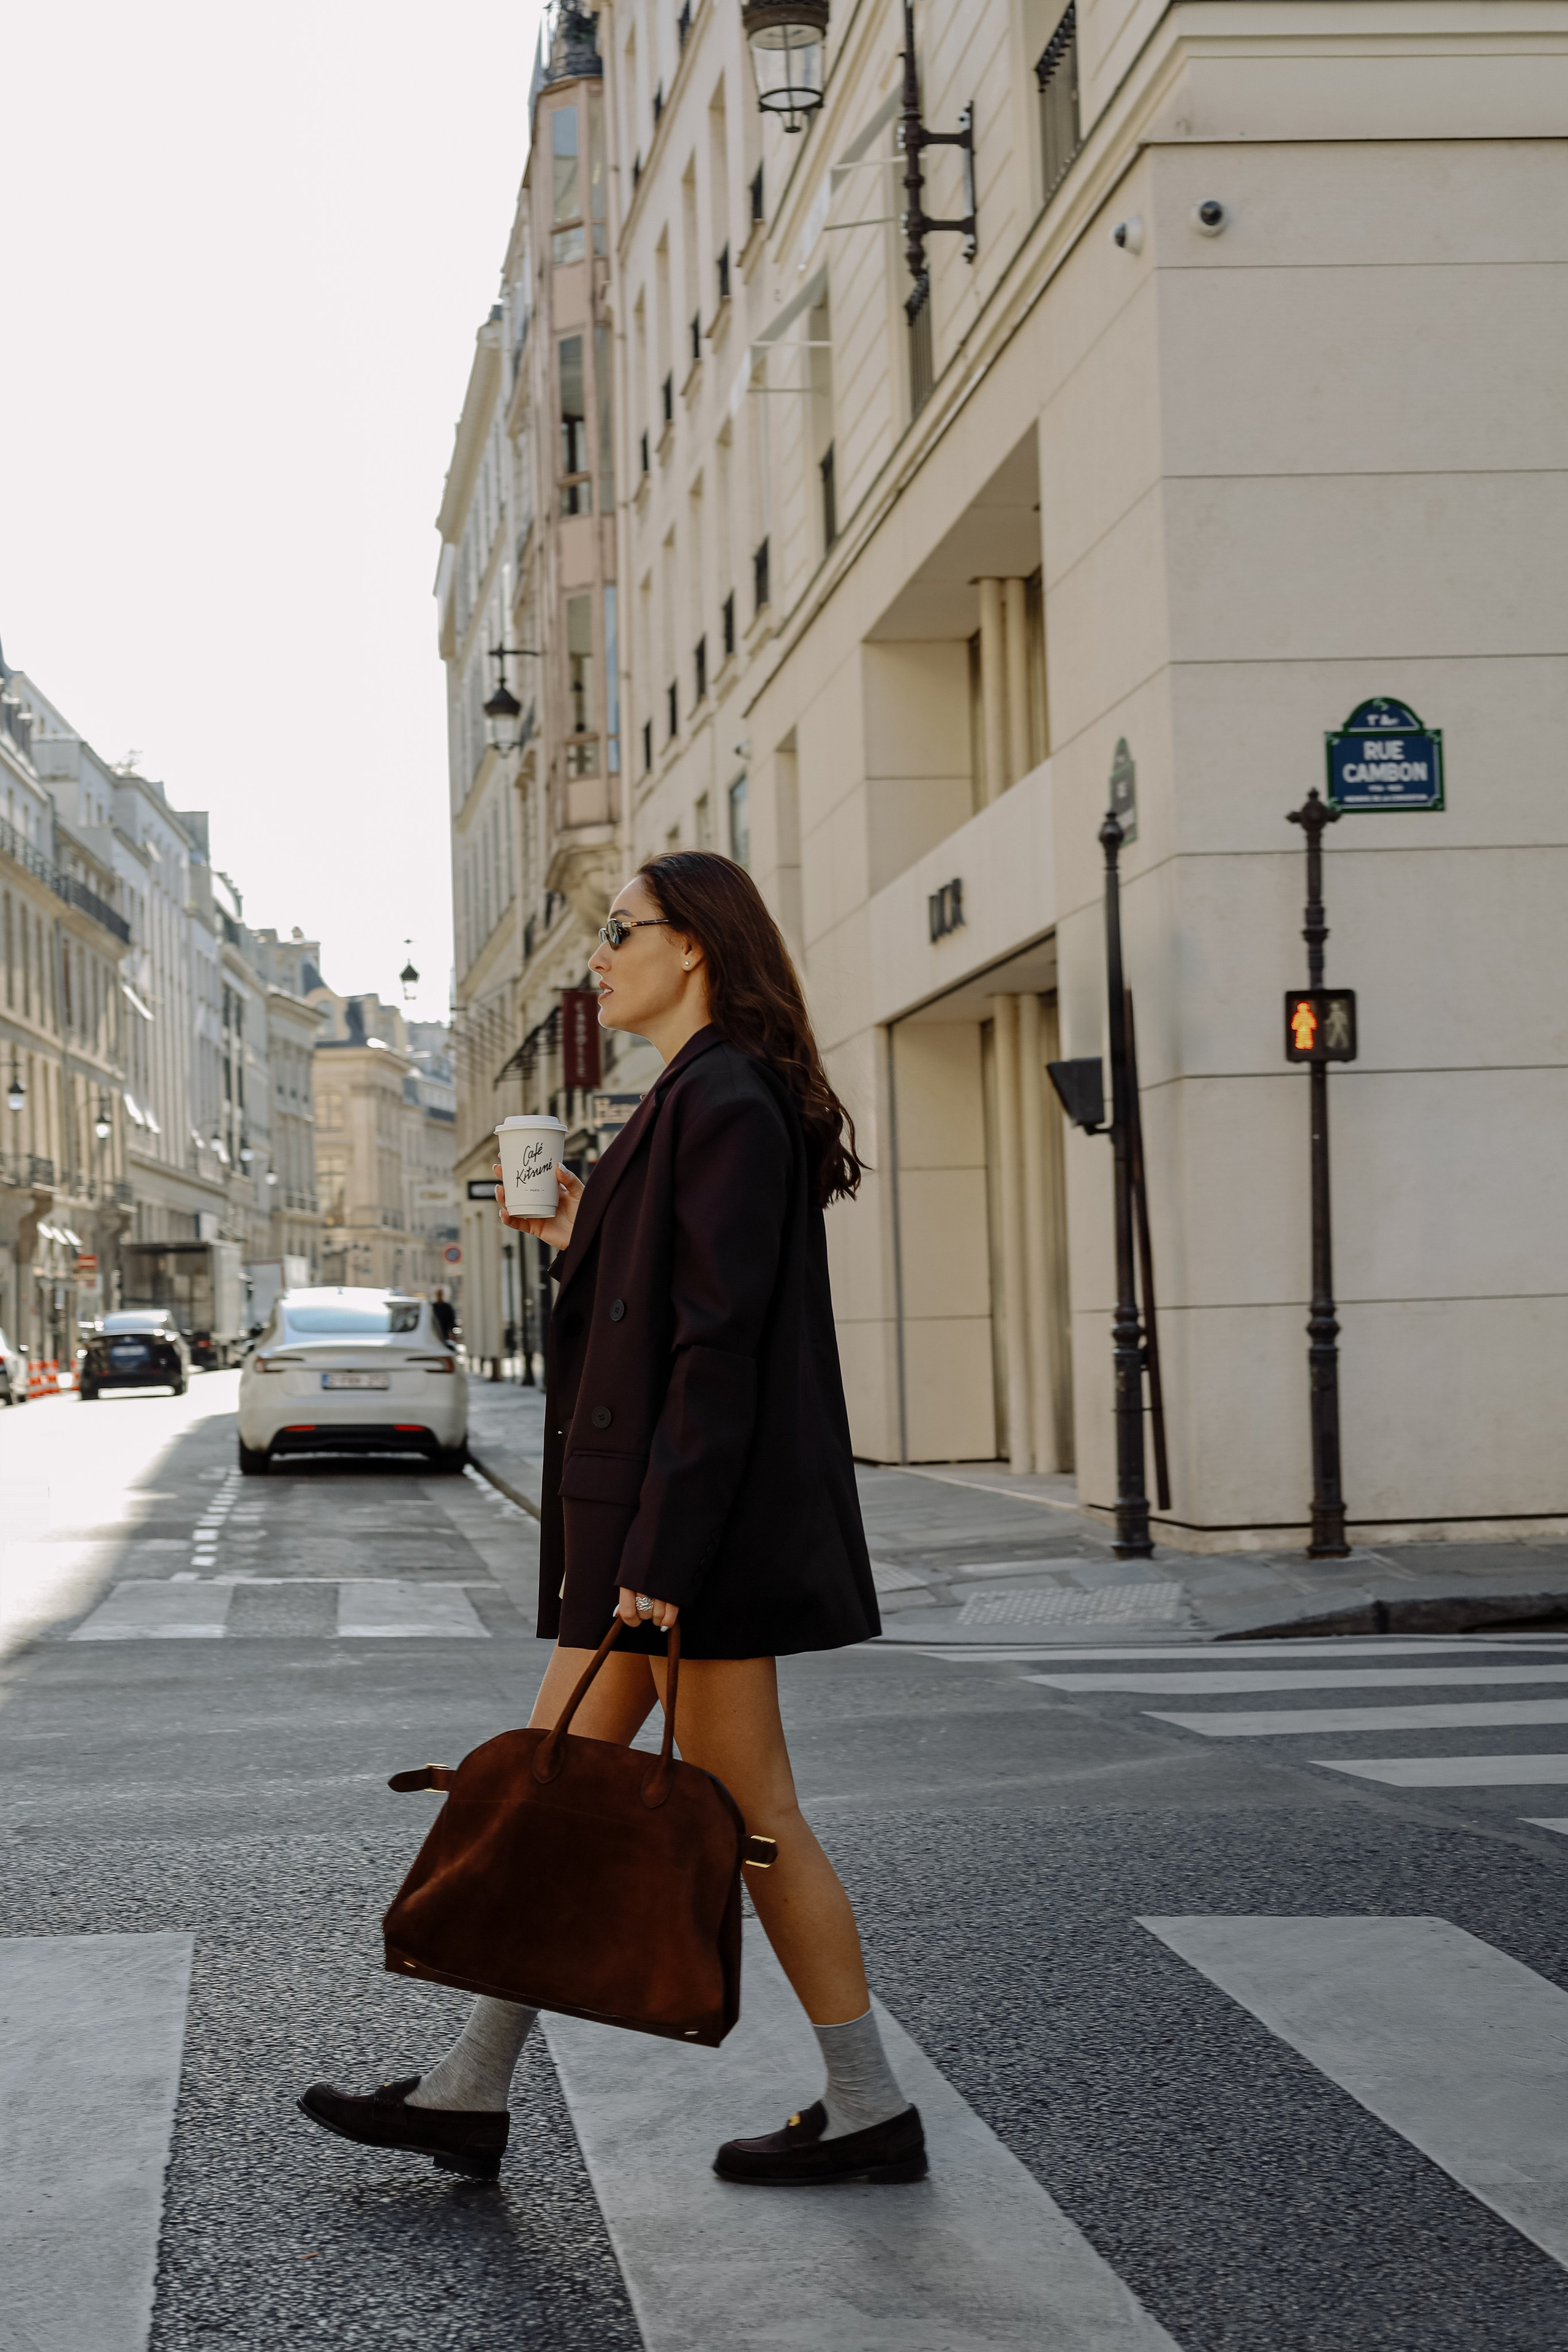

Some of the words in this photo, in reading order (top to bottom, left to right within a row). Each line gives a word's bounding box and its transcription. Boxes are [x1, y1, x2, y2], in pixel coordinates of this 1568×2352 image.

[1363, 741, 1405, 761] RUE
[1342, 762, 1428, 783] CAMBON
[523, 1142, 544, 1167] Café
[516, 1158, 553, 1188] Kitsuné
